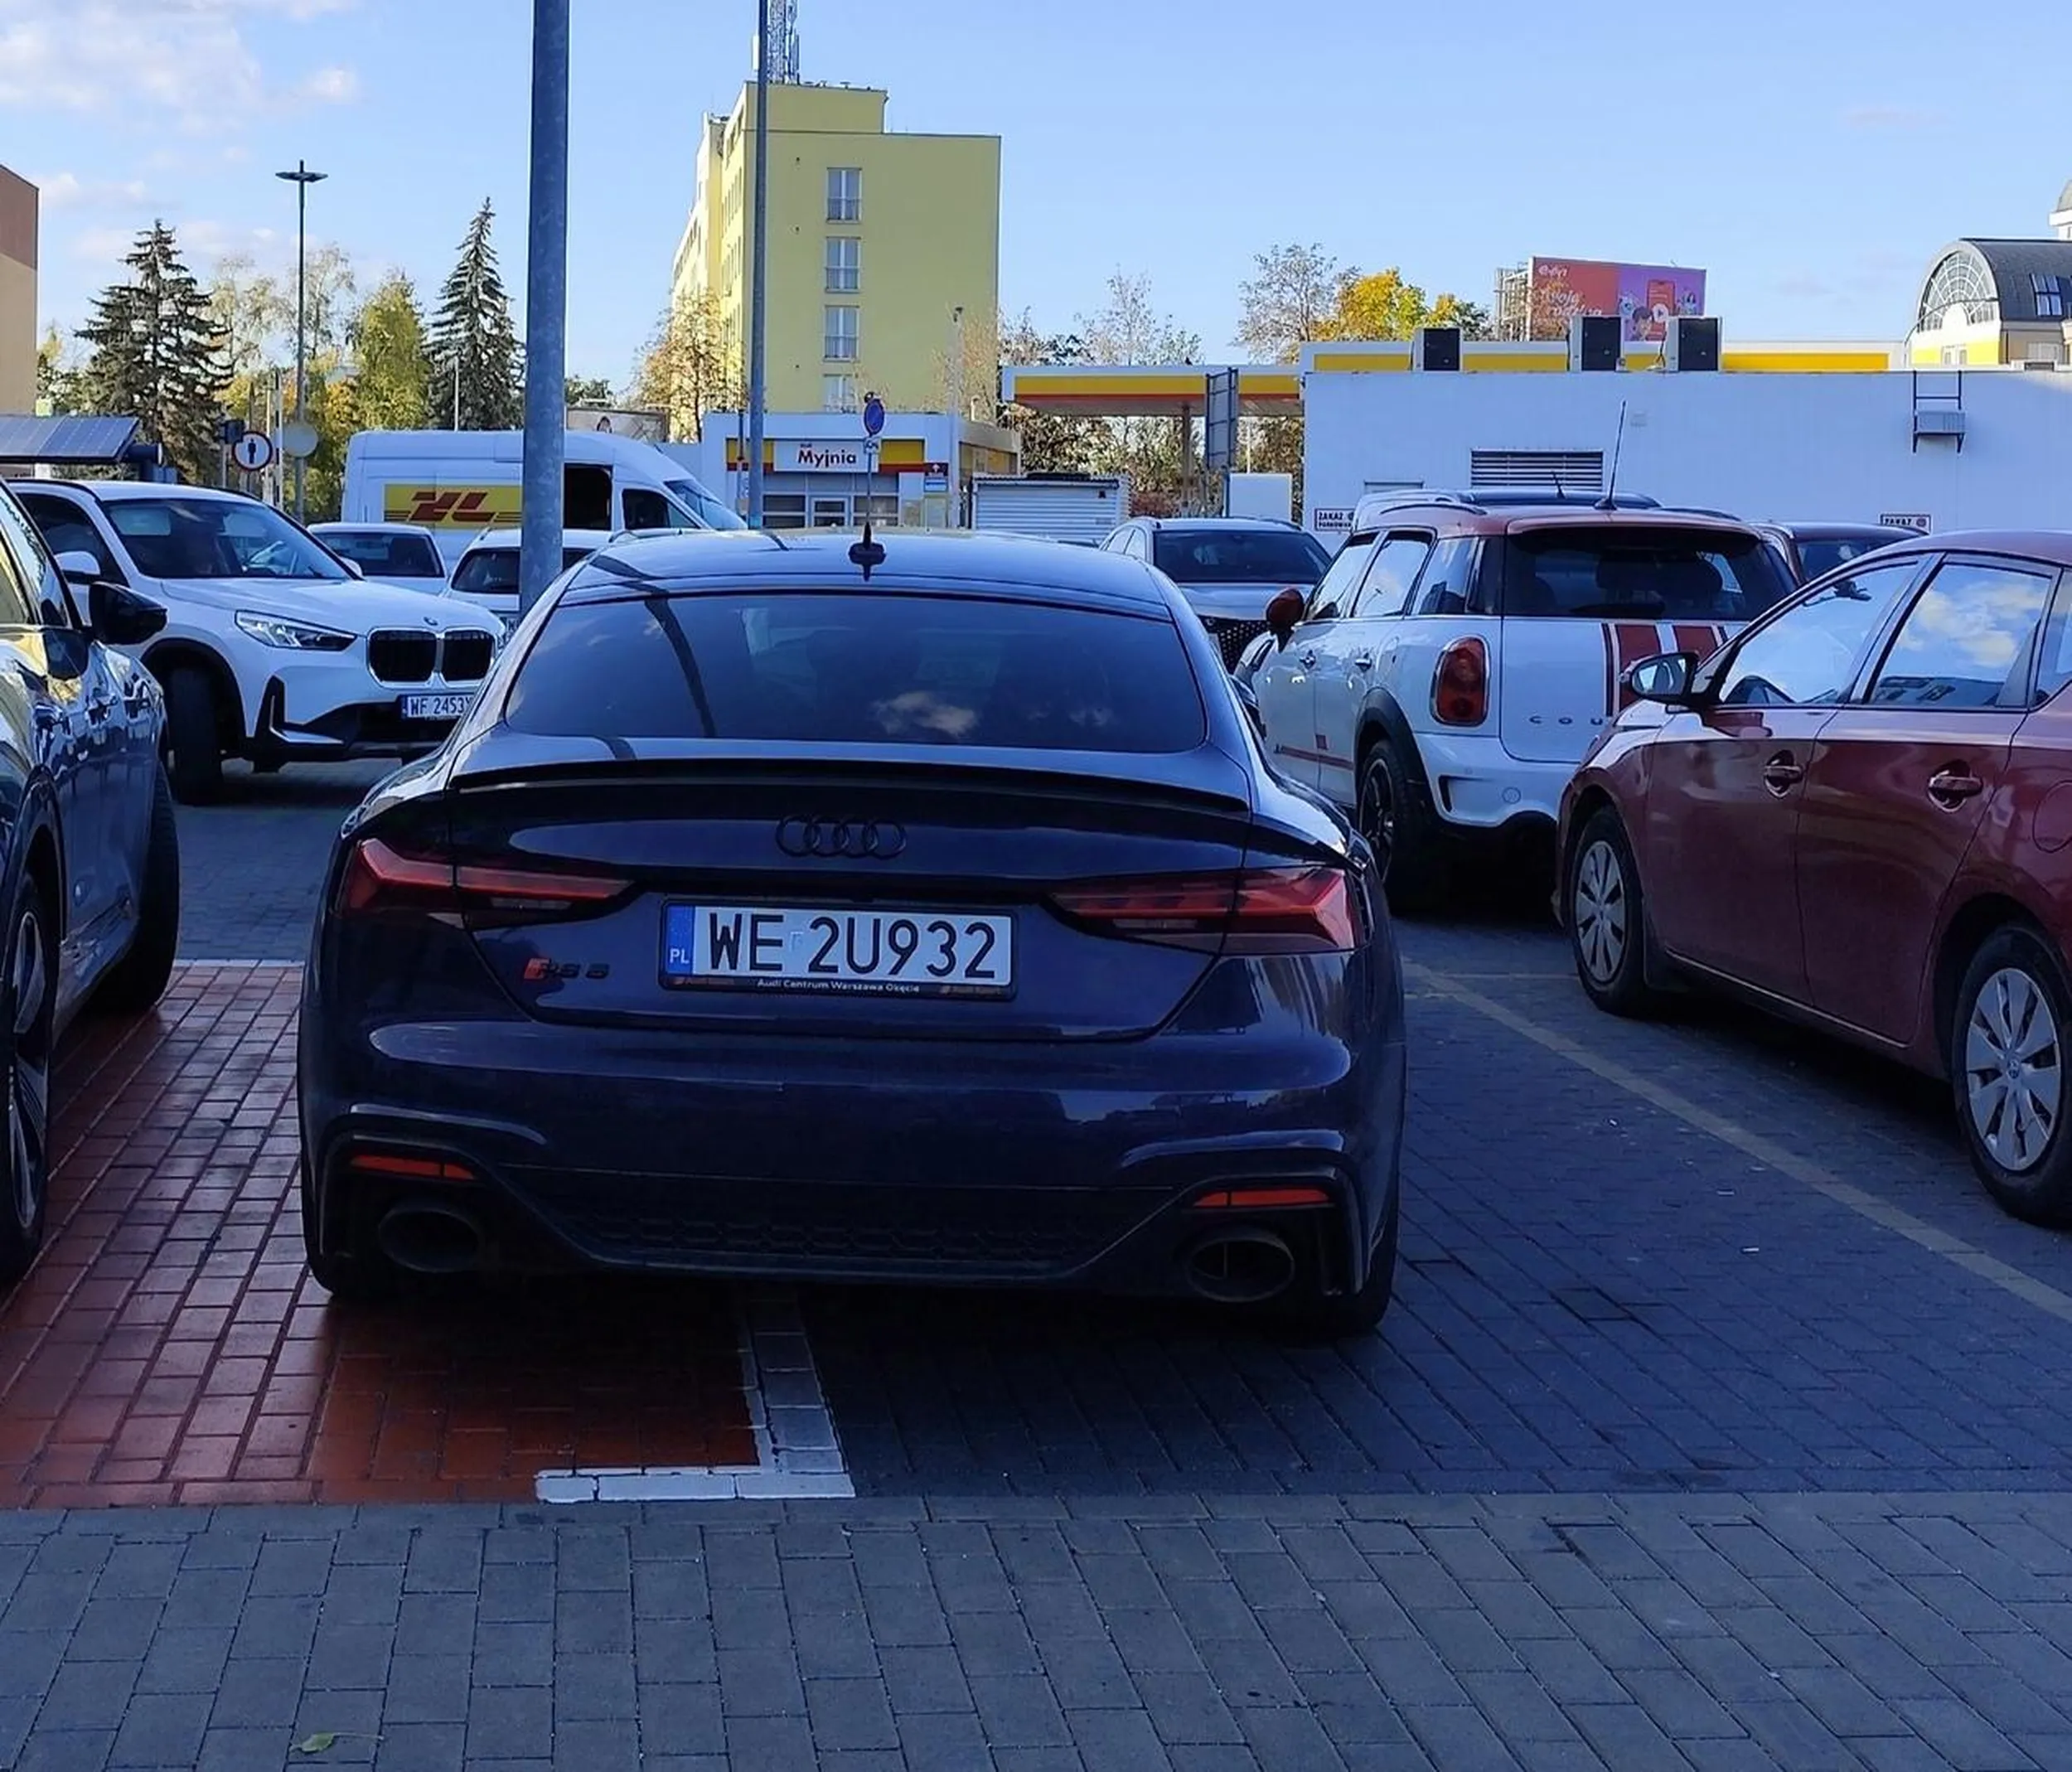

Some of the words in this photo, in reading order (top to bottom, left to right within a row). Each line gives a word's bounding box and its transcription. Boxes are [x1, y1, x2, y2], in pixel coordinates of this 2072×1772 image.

[798, 449, 857, 468] Myjnia
[1319, 511, 1343, 520] ZAKAZ
[410, 698, 428, 715] WF
[1528, 715, 1604, 725] COU
[709, 913, 784, 971] WE
[808, 917, 995, 979] 2U932
[669, 950, 690, 965] PL
[758, 980, 782, 989] Audi
[783, 980, 830, 990] Centrum
[830, 981, 884, 991] Warszawa
